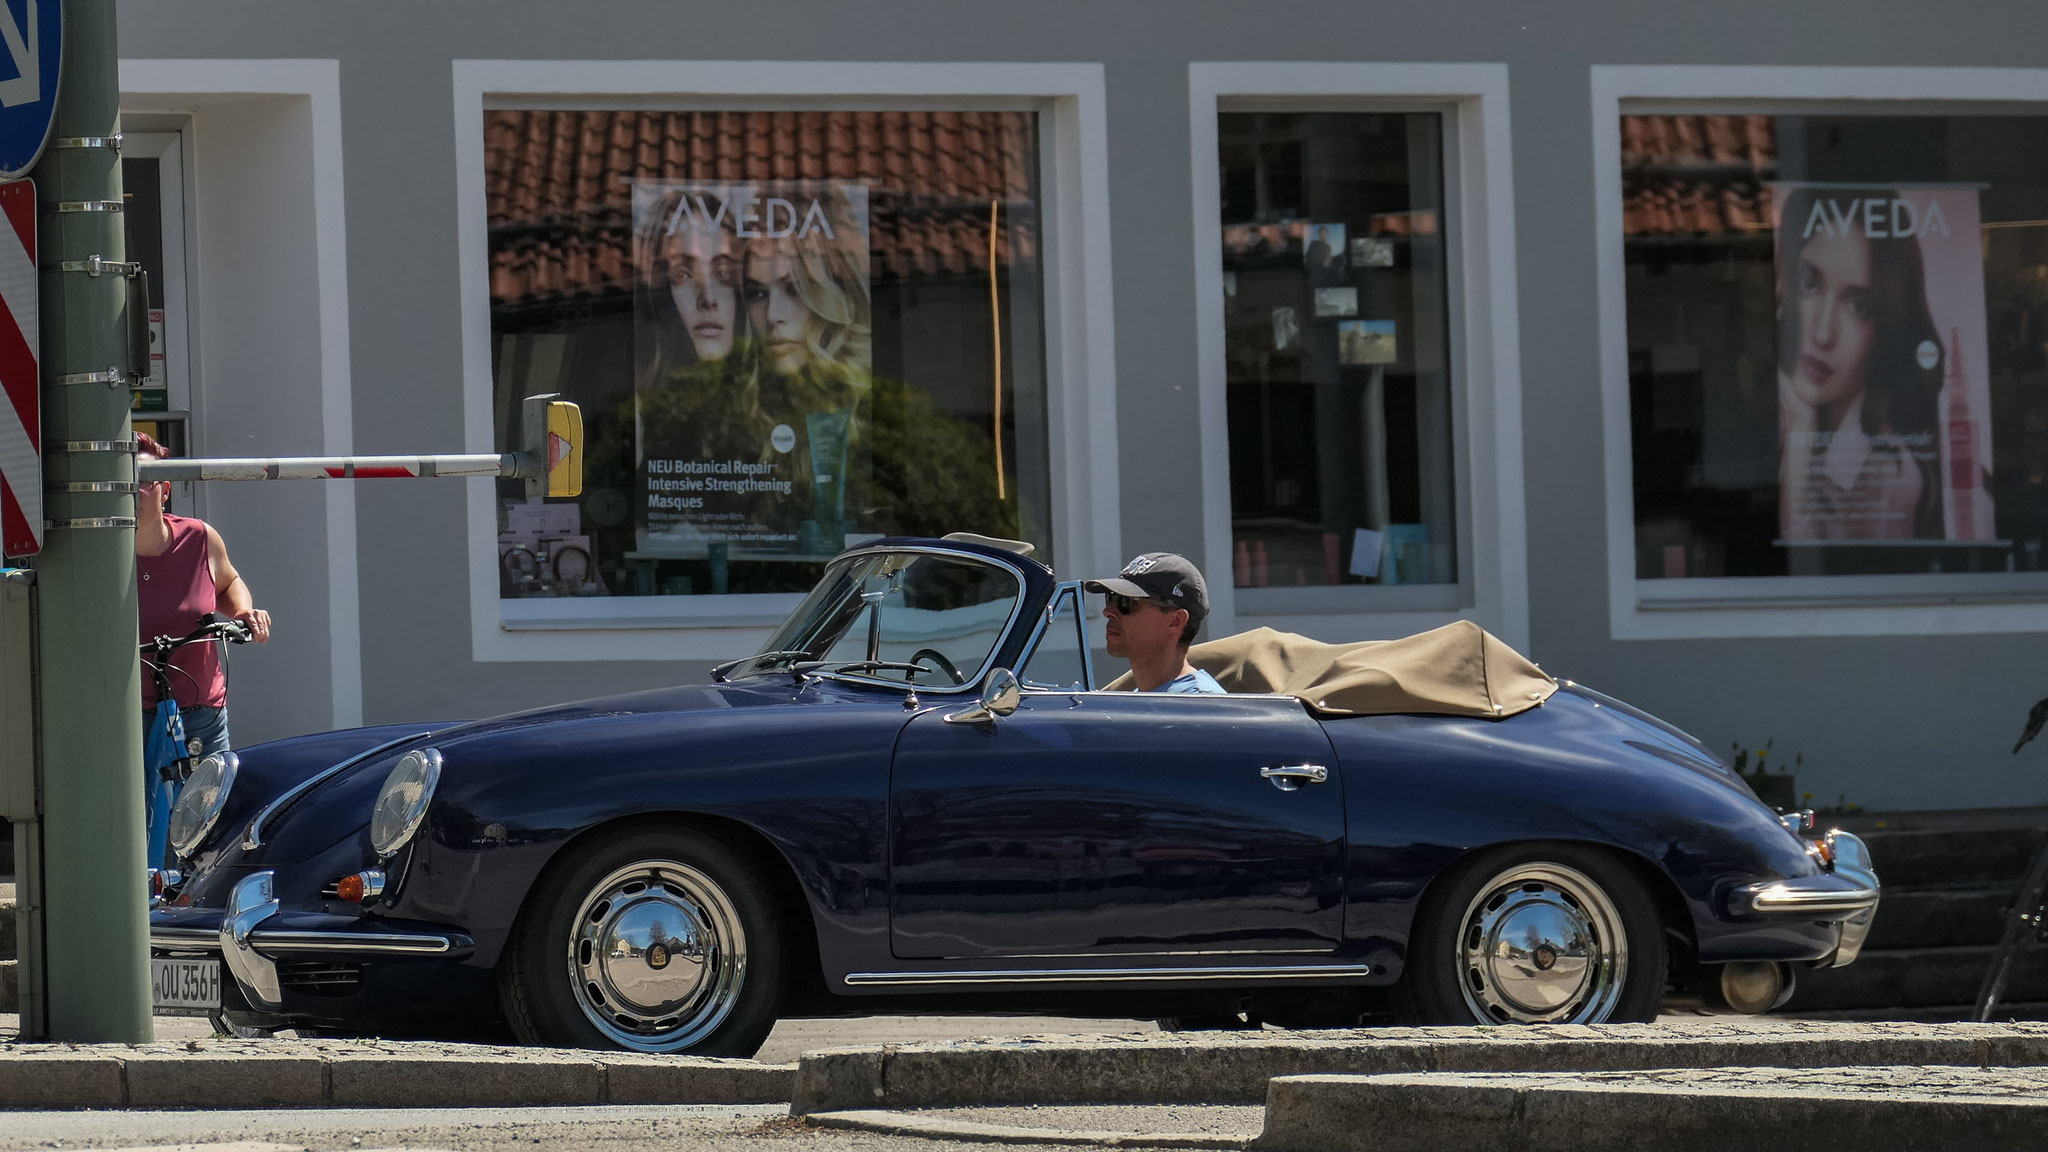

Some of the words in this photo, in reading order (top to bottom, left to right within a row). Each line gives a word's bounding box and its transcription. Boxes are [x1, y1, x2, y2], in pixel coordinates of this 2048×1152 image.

[666, 195, 834, 240] AVEDA
[1802, 198, 1949, 239] AVEDA
[648, 460, 673, 474] NEU
[675, 460, 731, 474] Botanical
[648, 477, 703, 491] Intensive
[705, 477, 792, 494] Strengthening
[648, 494, 703, 510] Masques
[162, 964, 179, 1000] OU
